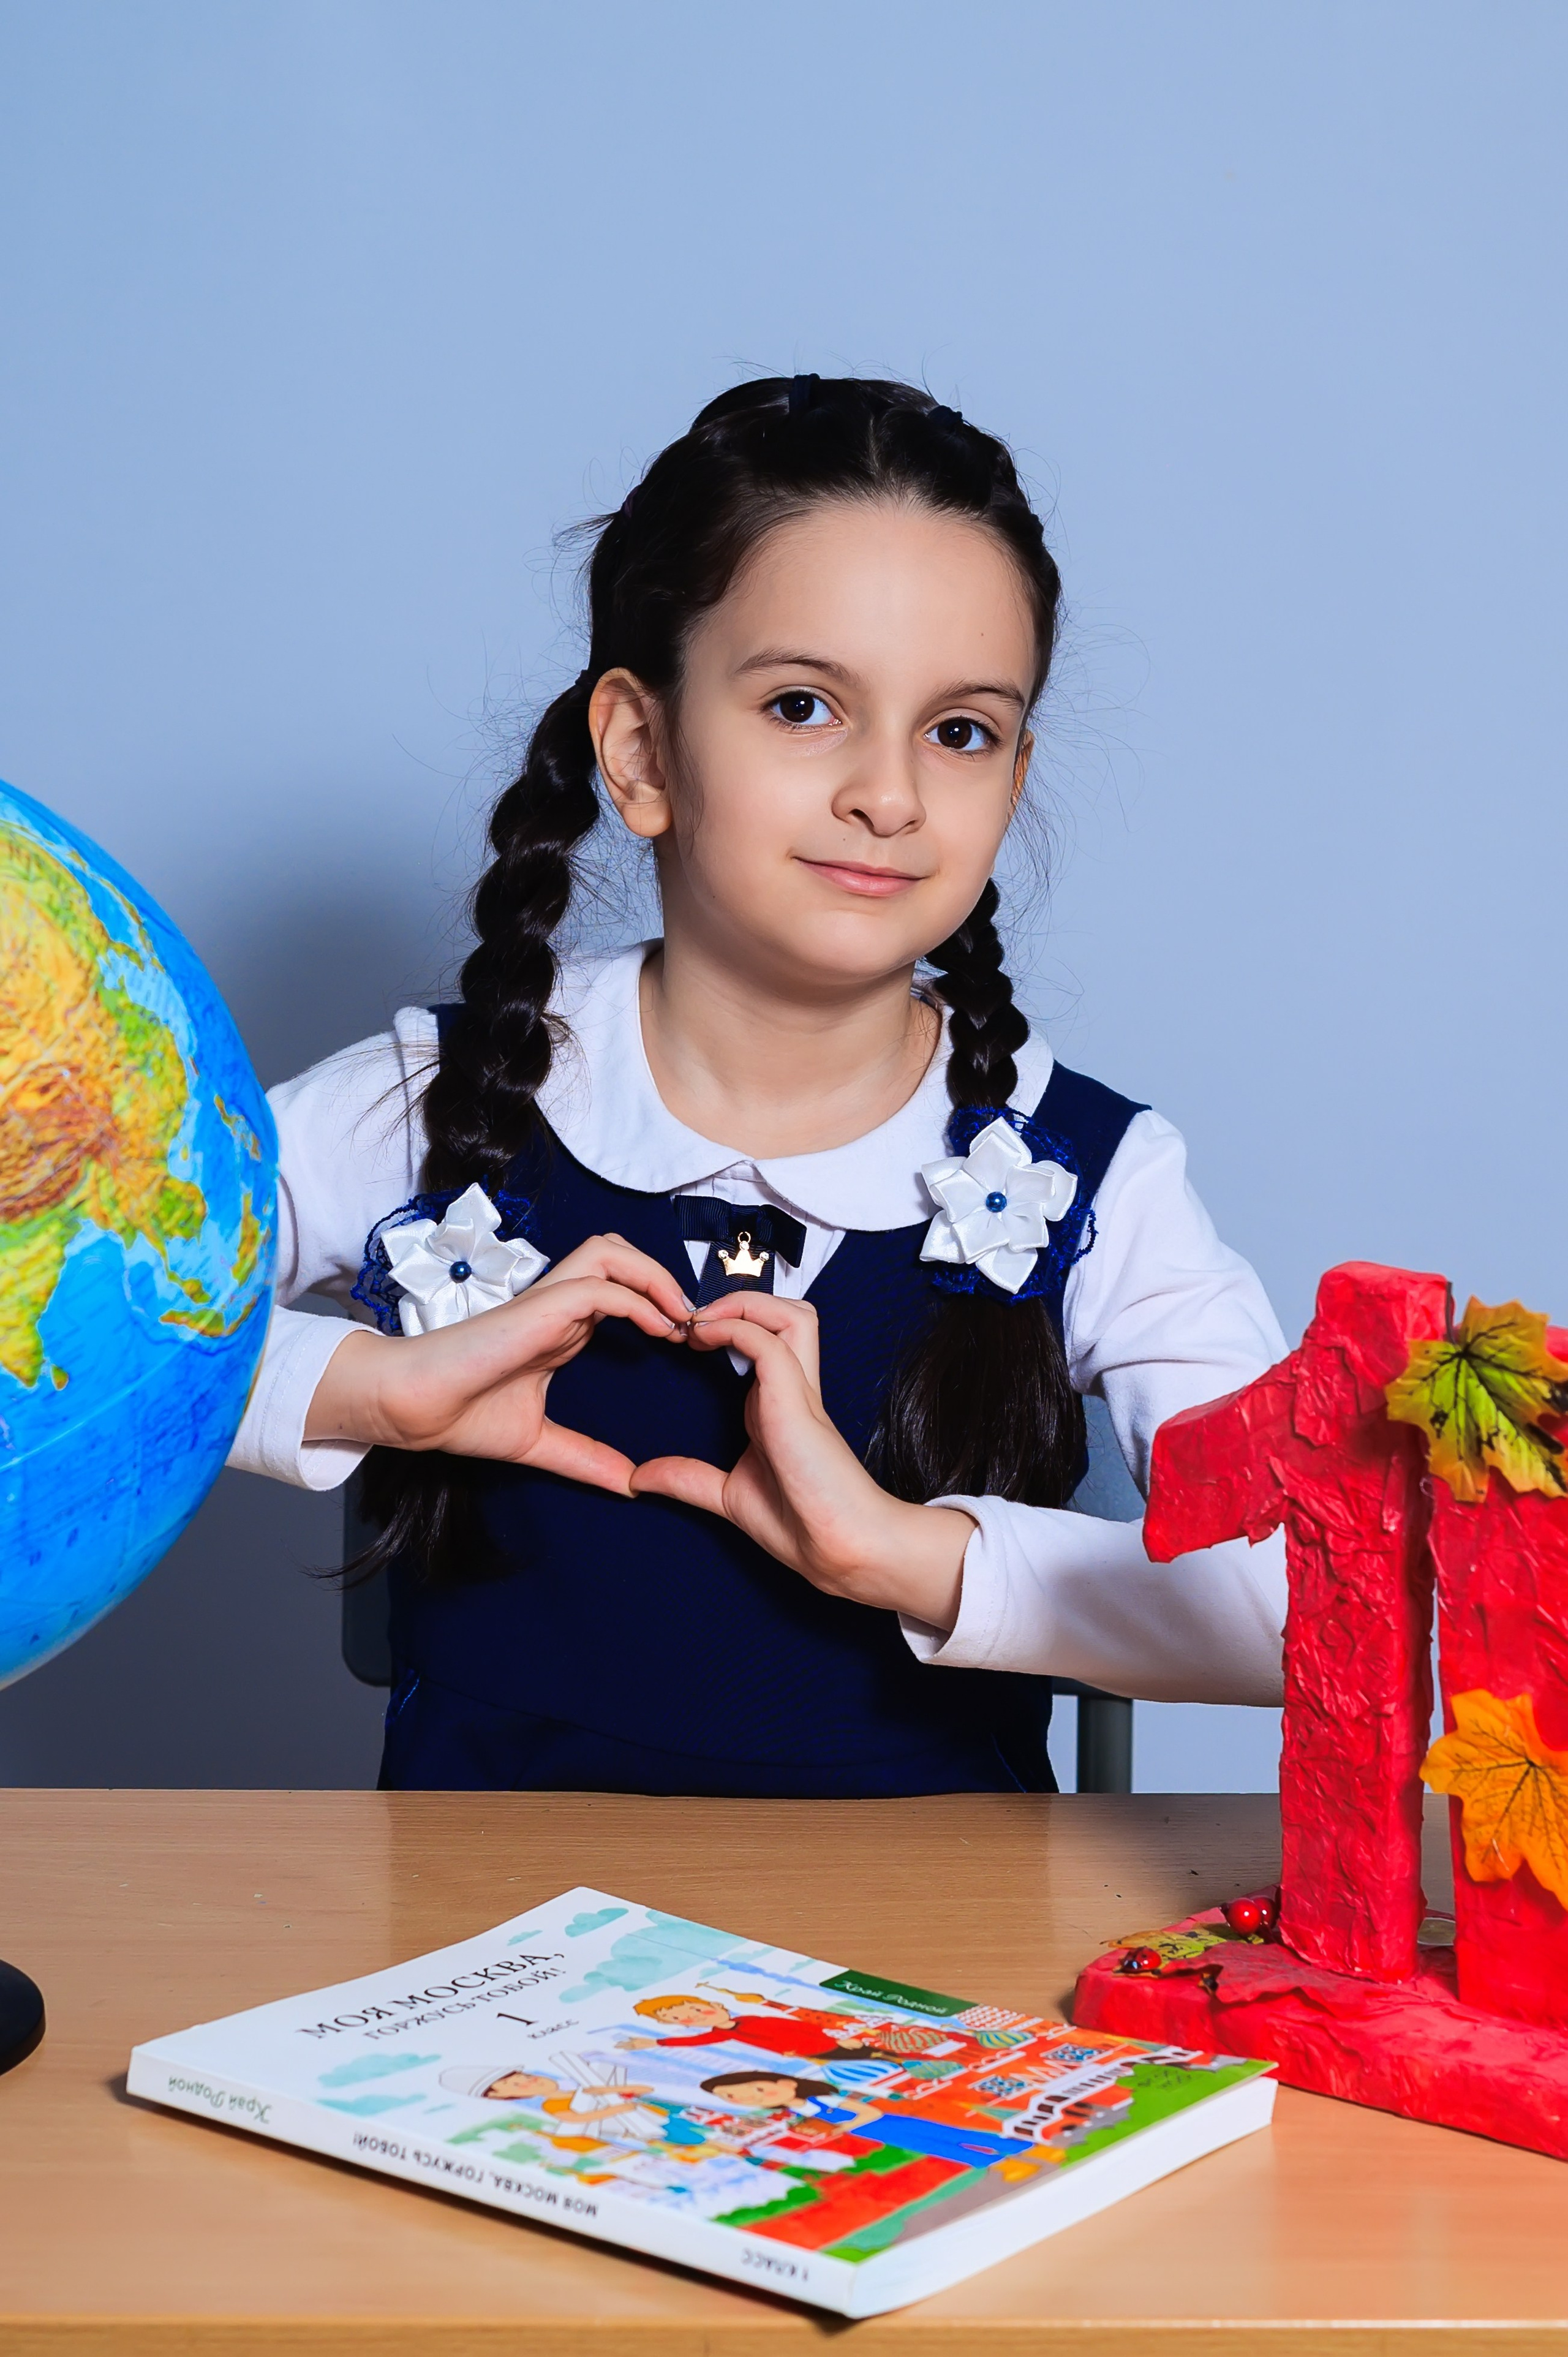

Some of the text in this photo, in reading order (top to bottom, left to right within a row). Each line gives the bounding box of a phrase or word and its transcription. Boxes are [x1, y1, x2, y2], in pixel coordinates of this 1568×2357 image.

[296, 1953, 565, 2038] МОЯ МОСКВА,
[363, 1967, 567, 2040] ГОРЖУСЬ ТОБОЙ!
[496, 2013, 539, 2026] 1
[168, 2076, 271, 2124] Край Родной
[353, 2131, 407, 2160] ТОБОЙ!
[413, 2149, 484, 2184] ГОРЖУСЬ
[564, 2196, 598, 2219] МОЯ
[741, 2247, 809, 2282] 1 КЛАСС
